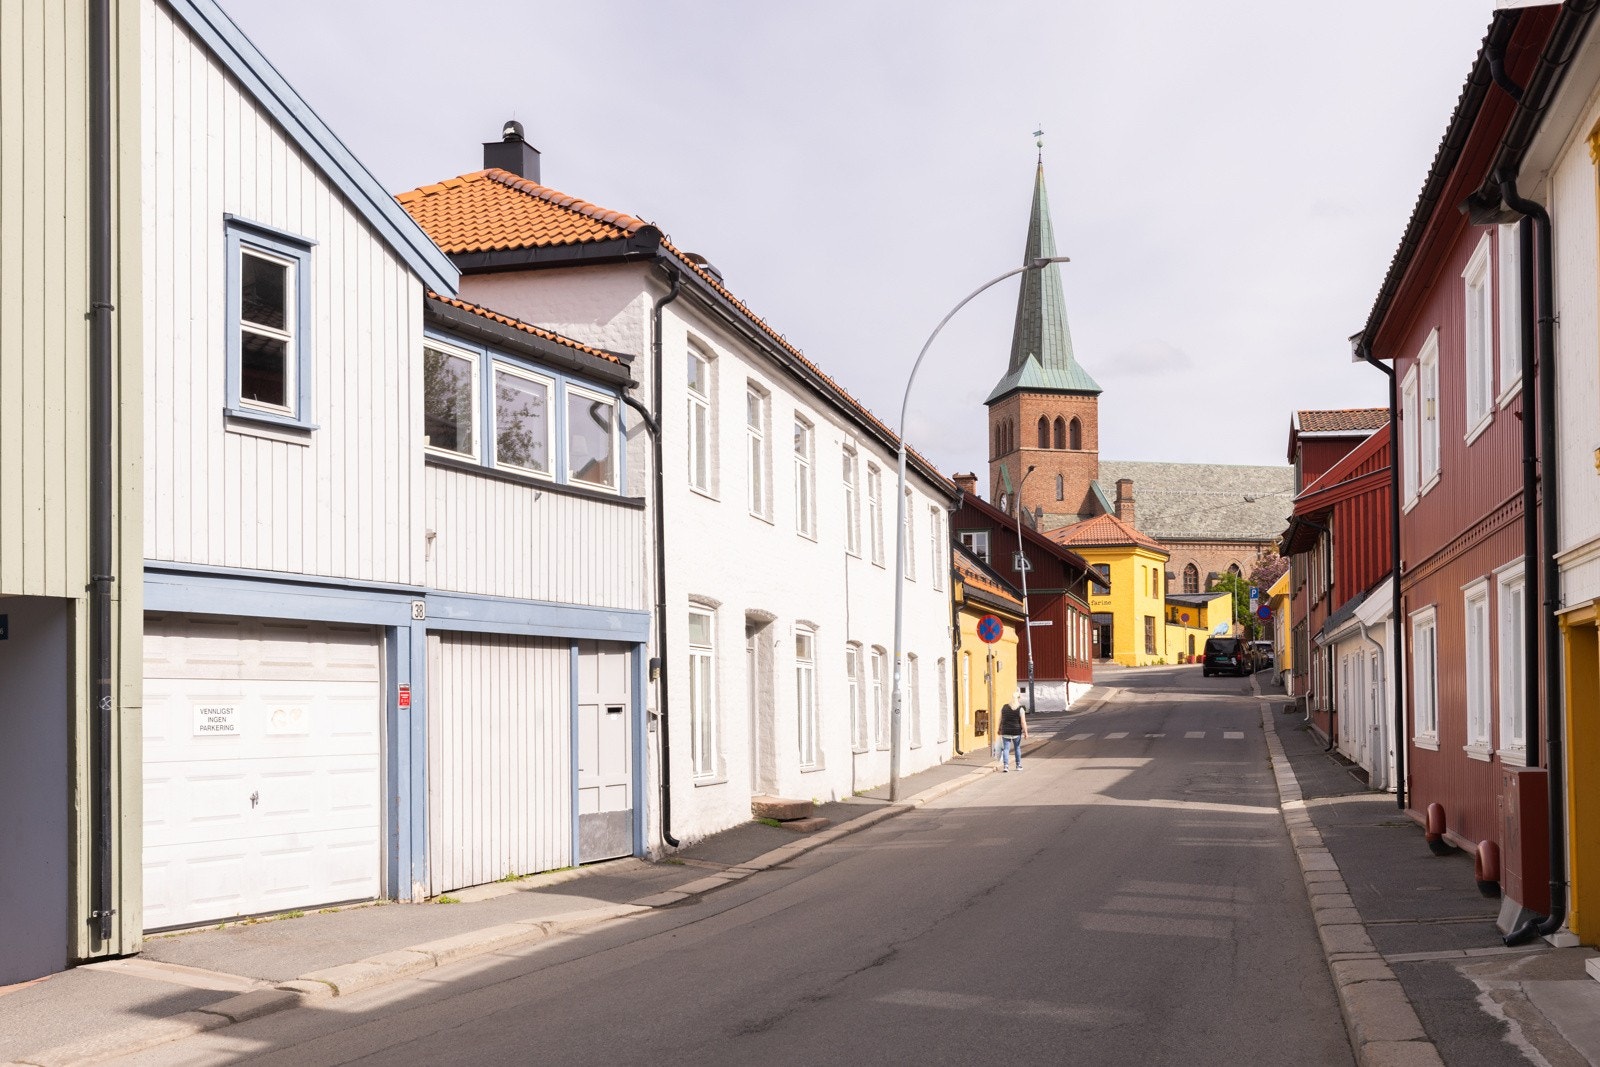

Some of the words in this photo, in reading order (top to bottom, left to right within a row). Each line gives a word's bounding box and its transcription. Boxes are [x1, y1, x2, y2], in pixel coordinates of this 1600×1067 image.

[1251, 589, 1257, 598] P
[415, 604, 423, 618] 38
[199, 724, 234, 732] PARKERING
